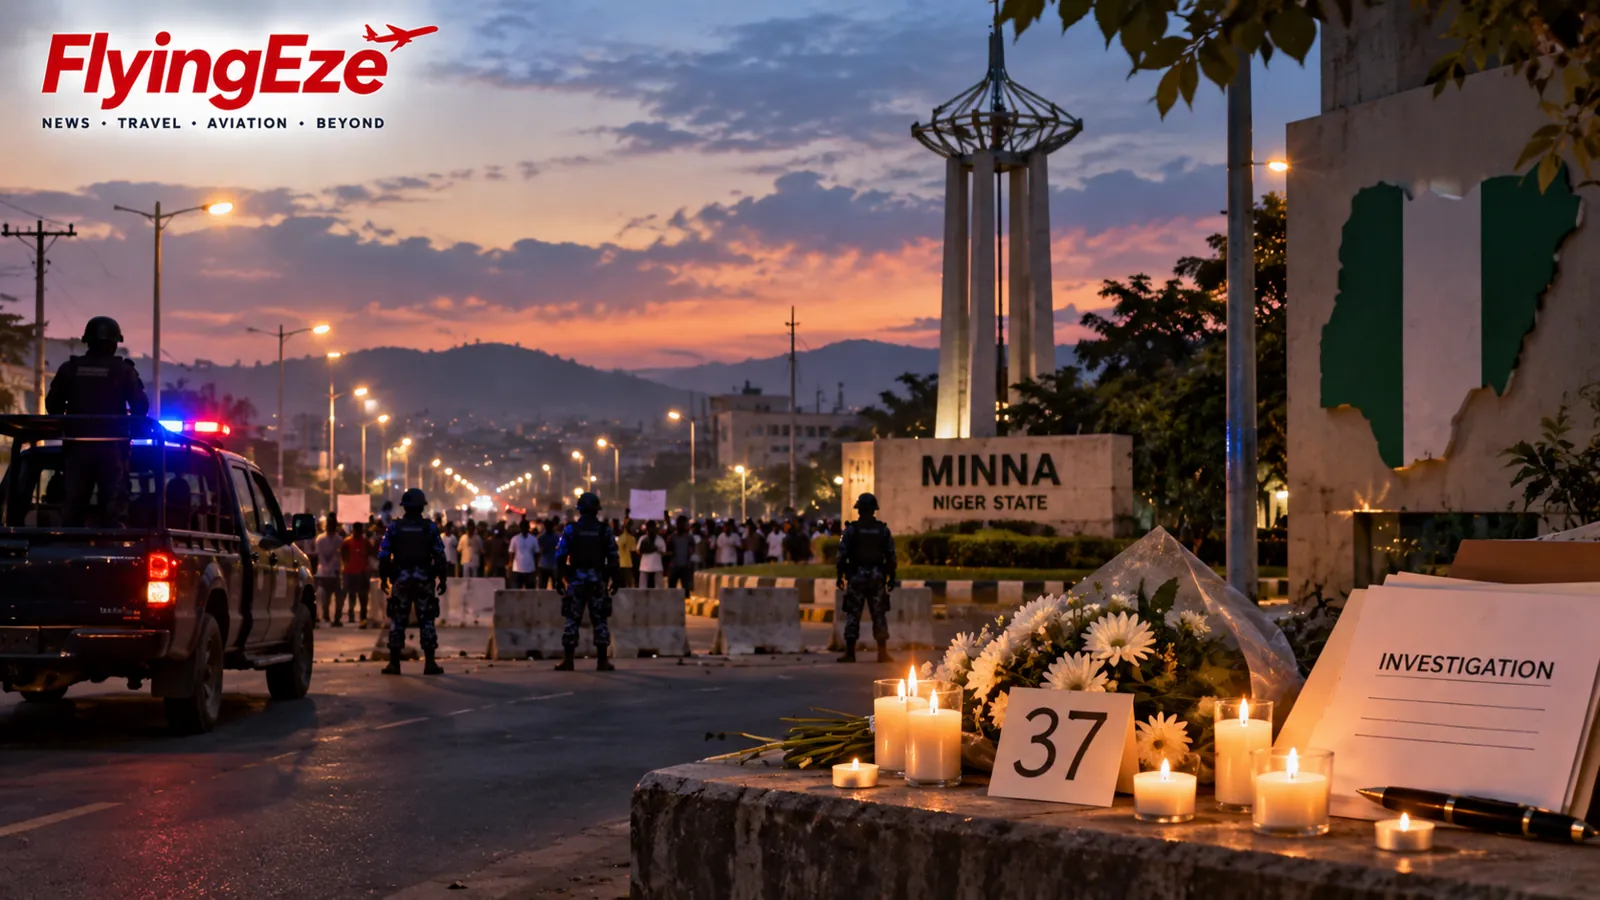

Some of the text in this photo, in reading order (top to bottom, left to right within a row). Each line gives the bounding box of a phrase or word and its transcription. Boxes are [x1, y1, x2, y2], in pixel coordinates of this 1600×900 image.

[921, 453, 1061, 487] MINNA
[932, 495, 1048, 511] NIGER STATE
[1378, 652, 1555, 680] INVESTIGATION
[1012, 707, 1108, 781] 37
